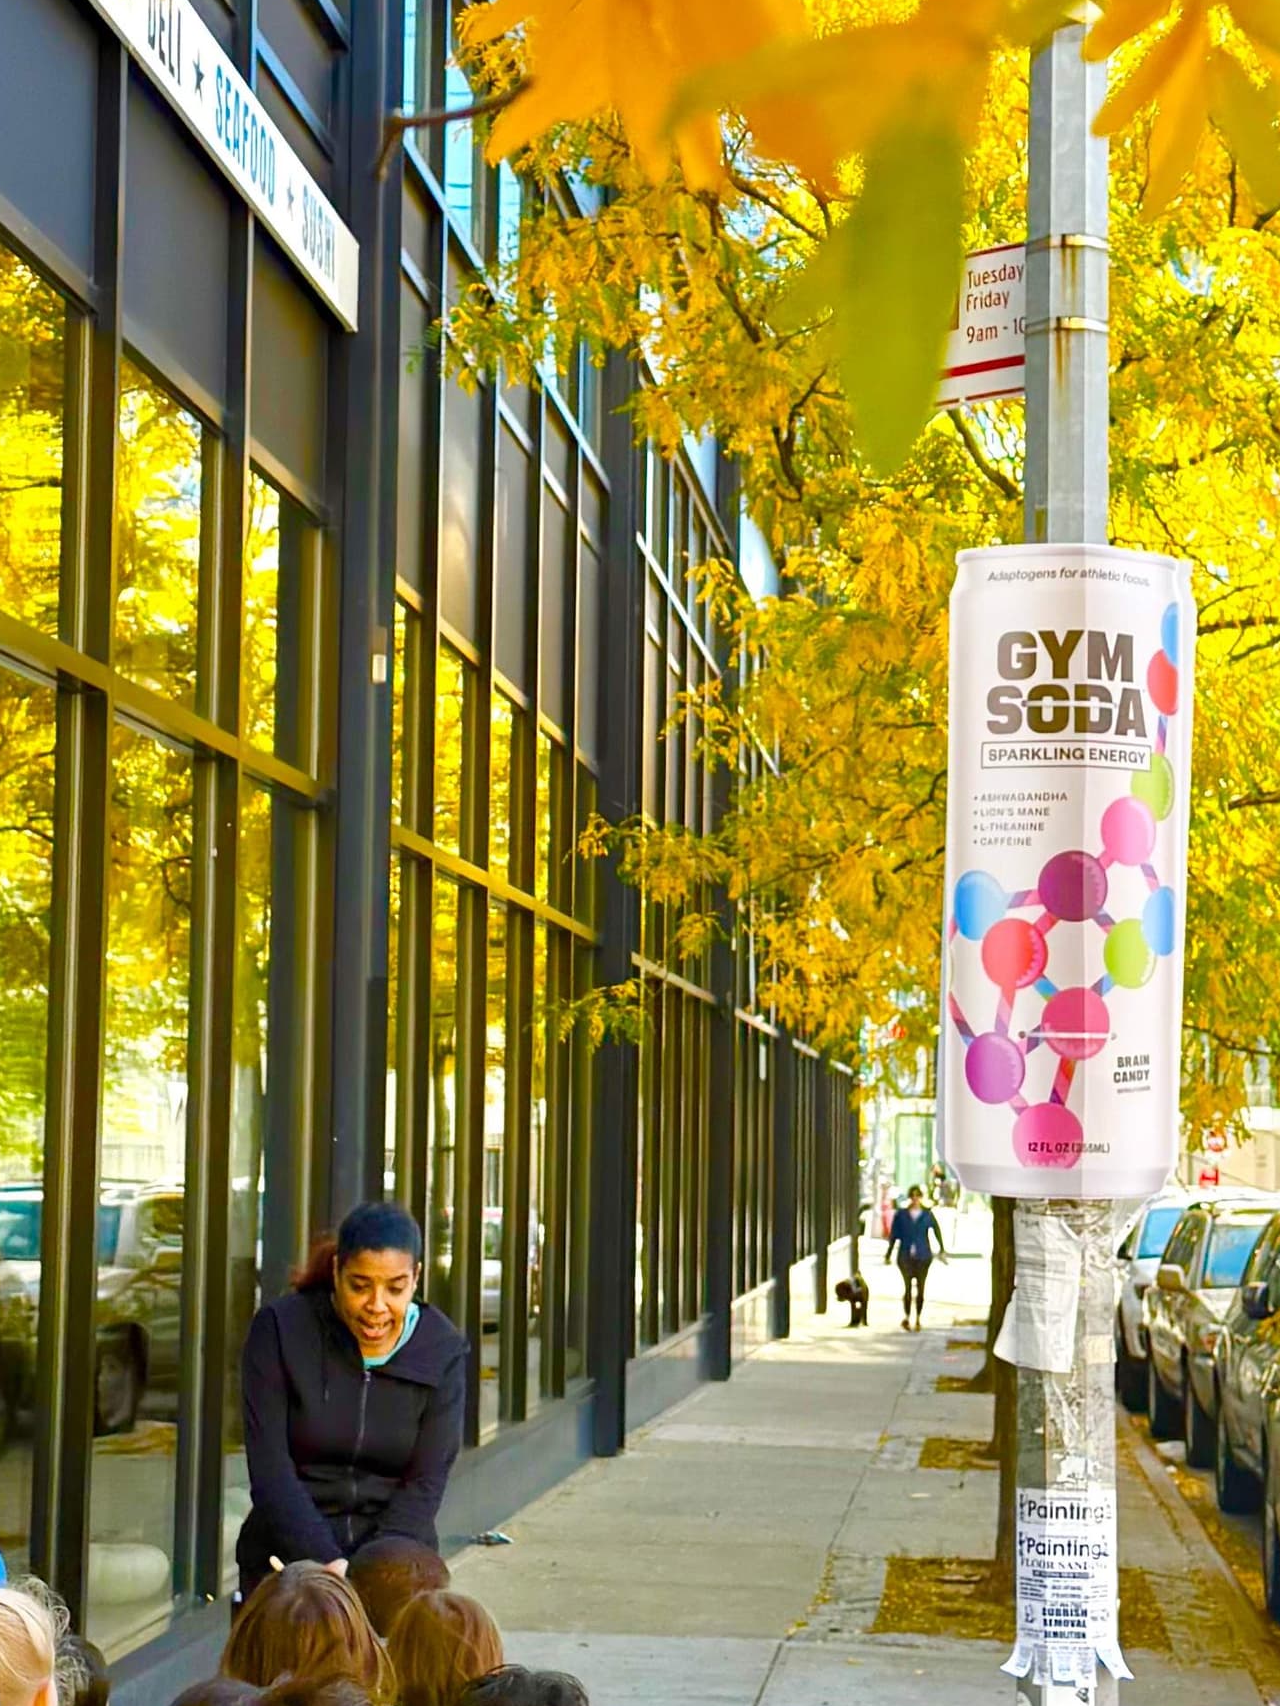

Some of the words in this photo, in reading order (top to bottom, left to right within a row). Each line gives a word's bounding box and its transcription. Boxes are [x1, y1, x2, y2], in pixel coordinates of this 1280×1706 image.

[214, 62, 276, 208] SEAFOOD
[302, 180, 336, 285] SUSHI
[967, 263, 1024, 289] Tuesday
[966, 291, 1010, 312] Friday
[966, 325, 998, 344] 9am
[987, 567, 1057, 583] Adaptogens
[1059, 567, 1078, 580] for
[1080, 568, 1120, 583] athletic
[997, 629, 1134, 683] GYM
[986, 684, 1147, 738] SODA
[988, 747, 1085, 762] SPARKLING
[1088, 748, 1146, 764] ENERGY
[1017, 807, 1051, 817] MANE
[980, 821, 1045, 832] L-THEANINE
[980, 836, 1032, 847] CAFFEINE
[1117, 1054, 1150, 1068] BRAIN
[1113, 1070, 1150, 1084] CANDY
[1028, 1142, 1038, 1152] 12
[1039, 1142, 1053, 1153] FL
[1055, 1142, 1069, 1153] OZ
[1027, 1499, 1105, 1524] Painting
[1026, 1537, 1102, 1559] Painting
